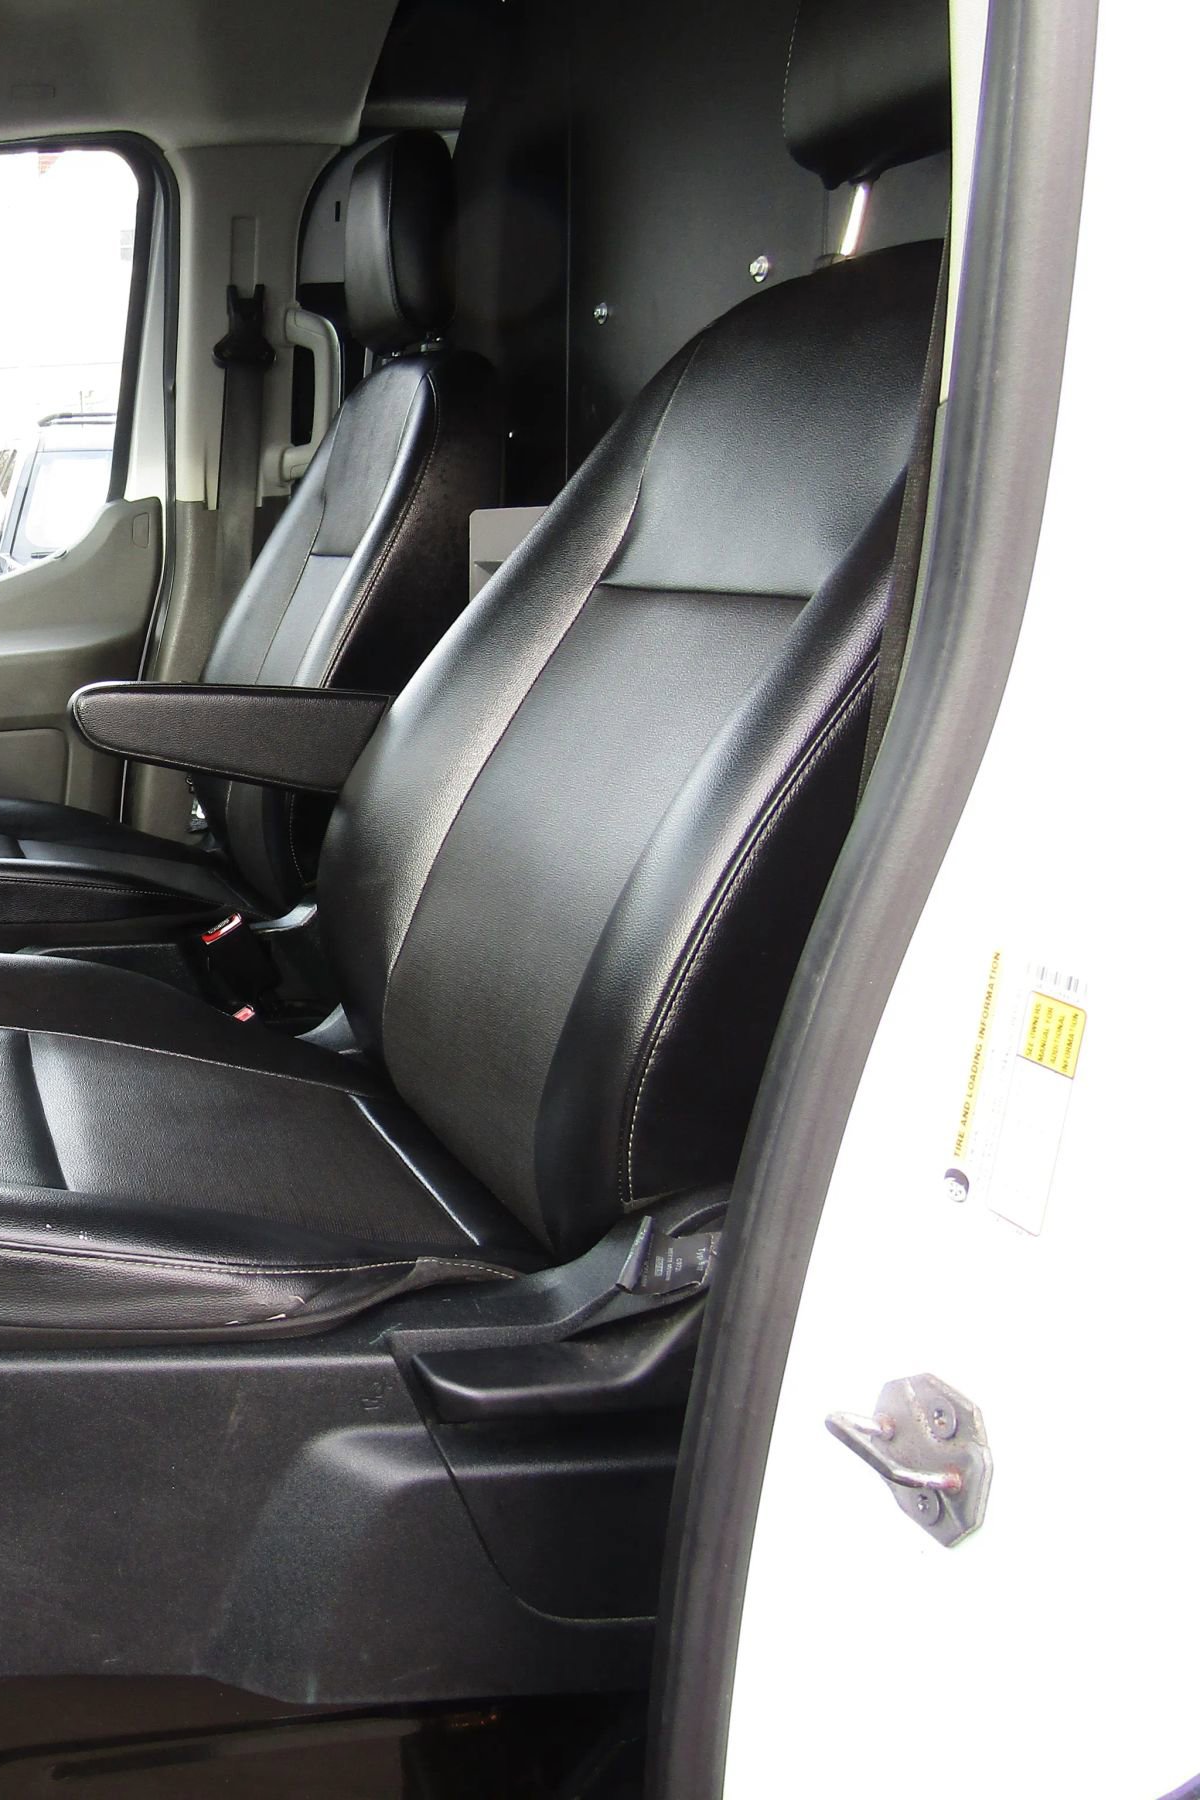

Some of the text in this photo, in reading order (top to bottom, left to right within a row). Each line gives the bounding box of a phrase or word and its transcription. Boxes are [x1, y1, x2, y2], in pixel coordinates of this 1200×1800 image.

[953, 951, 1001, 1158] TIRE AND LOADING INFORMATION
[1025, 1003, 1042, 1057] SEE OWNERS
[1037, 1007, 1054, 1062] MANUAL FOR
[1050, 1015, 1065, 1064] ADDITIONAL
[1061, 1012, 1079, 1073] INFORMATION
